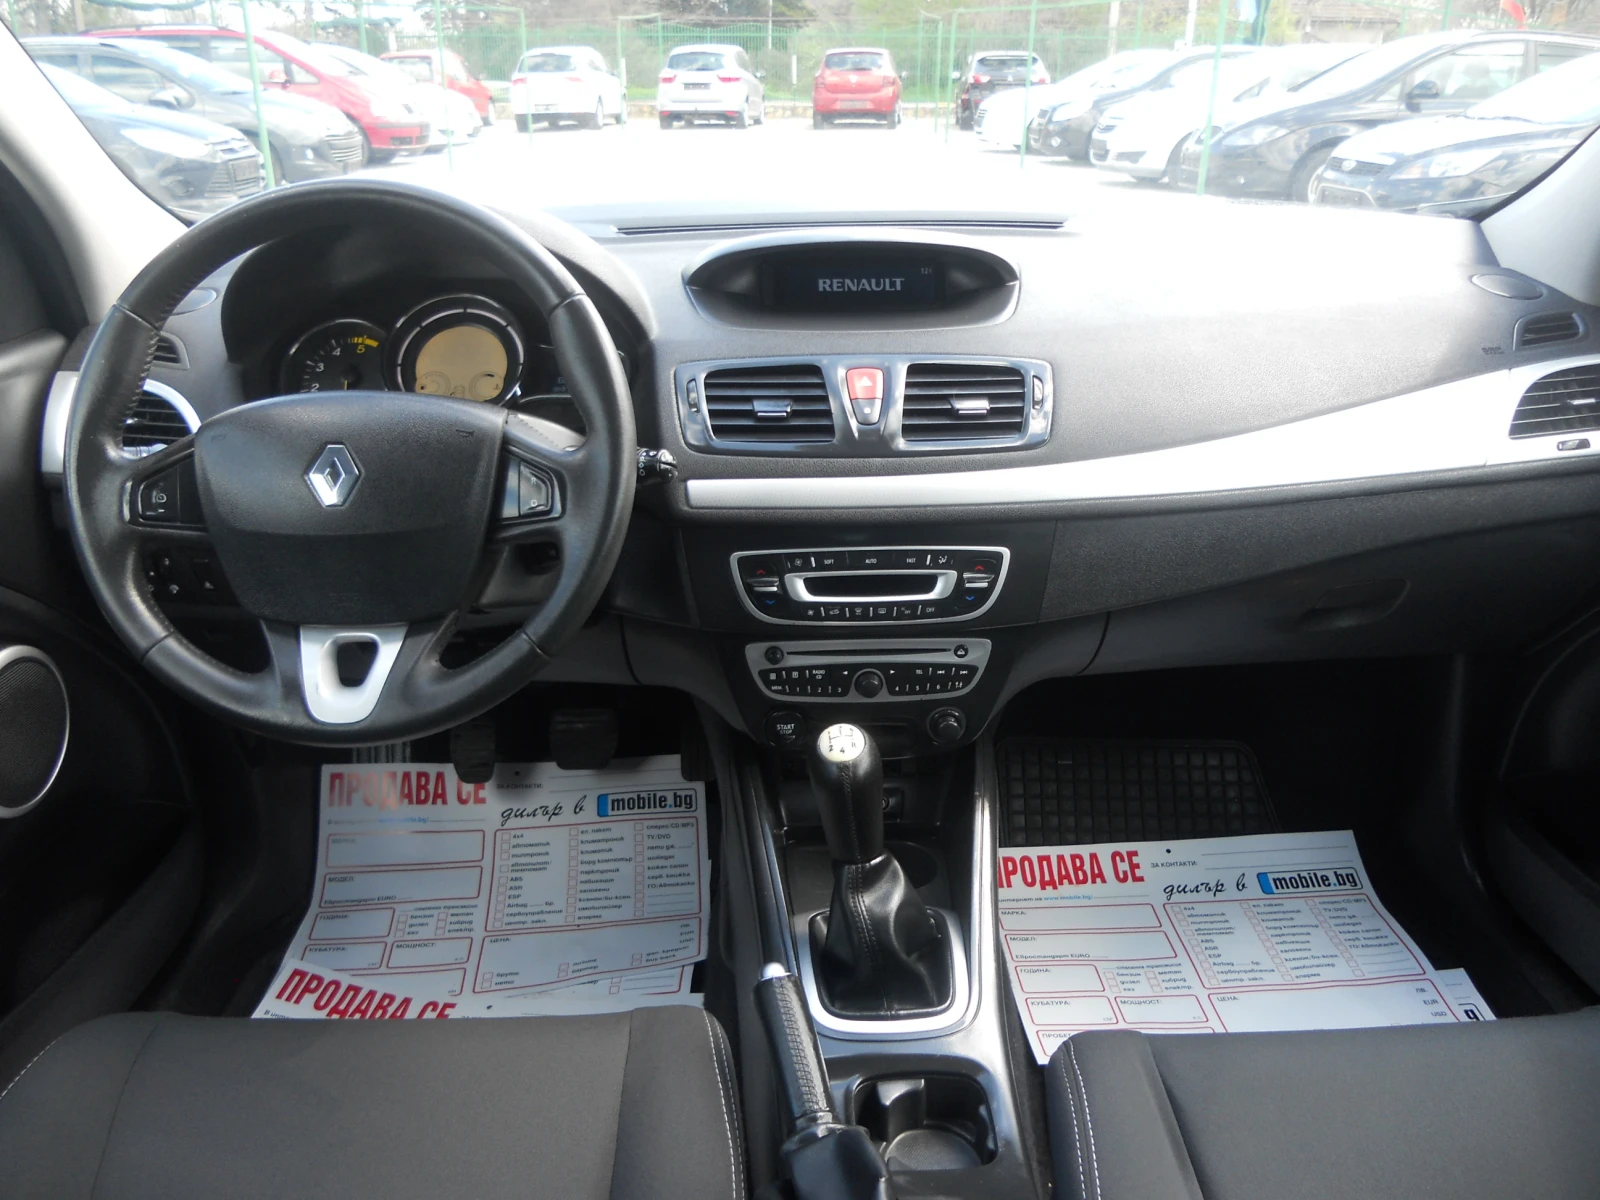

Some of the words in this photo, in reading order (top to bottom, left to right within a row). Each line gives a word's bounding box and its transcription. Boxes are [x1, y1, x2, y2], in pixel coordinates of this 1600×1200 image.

[817, 278, 905, 292] RENAULT
[332, 347, 341, 357] 4
[356, 344, 366, 354] 5
[316, 362, 325, 372] 3
[311, 383, 320, 392] 2
[776, 723, 795, 731] START
[828, 744, 834, 752] 2
[839, 746, 846, 754] 4
[328, 771, 448, 811] ПРОДАВА
[611, 791, 694, 812] mobile.bg
[501, 802, 563, 827] дилър
[511, 841, 550, 849] автоматик
[580, 836, 625, 845] климатроник
[511, 851, 550, 859] типтроник
[580, 847, 613, 855] климатик
[1110, 850, 1145, 884] СЕ
[1160, 860, 1198, 868] КОНТАКТИ:
[580, 867, 620, 875] парктроник
[1271, 870, 1358, 890] mobile.bg
[1163, 879, 1227, 901] дилър
[1236, 872, 1248, 892] в
[275, 968, 413, 1019] ПРОДАВА
